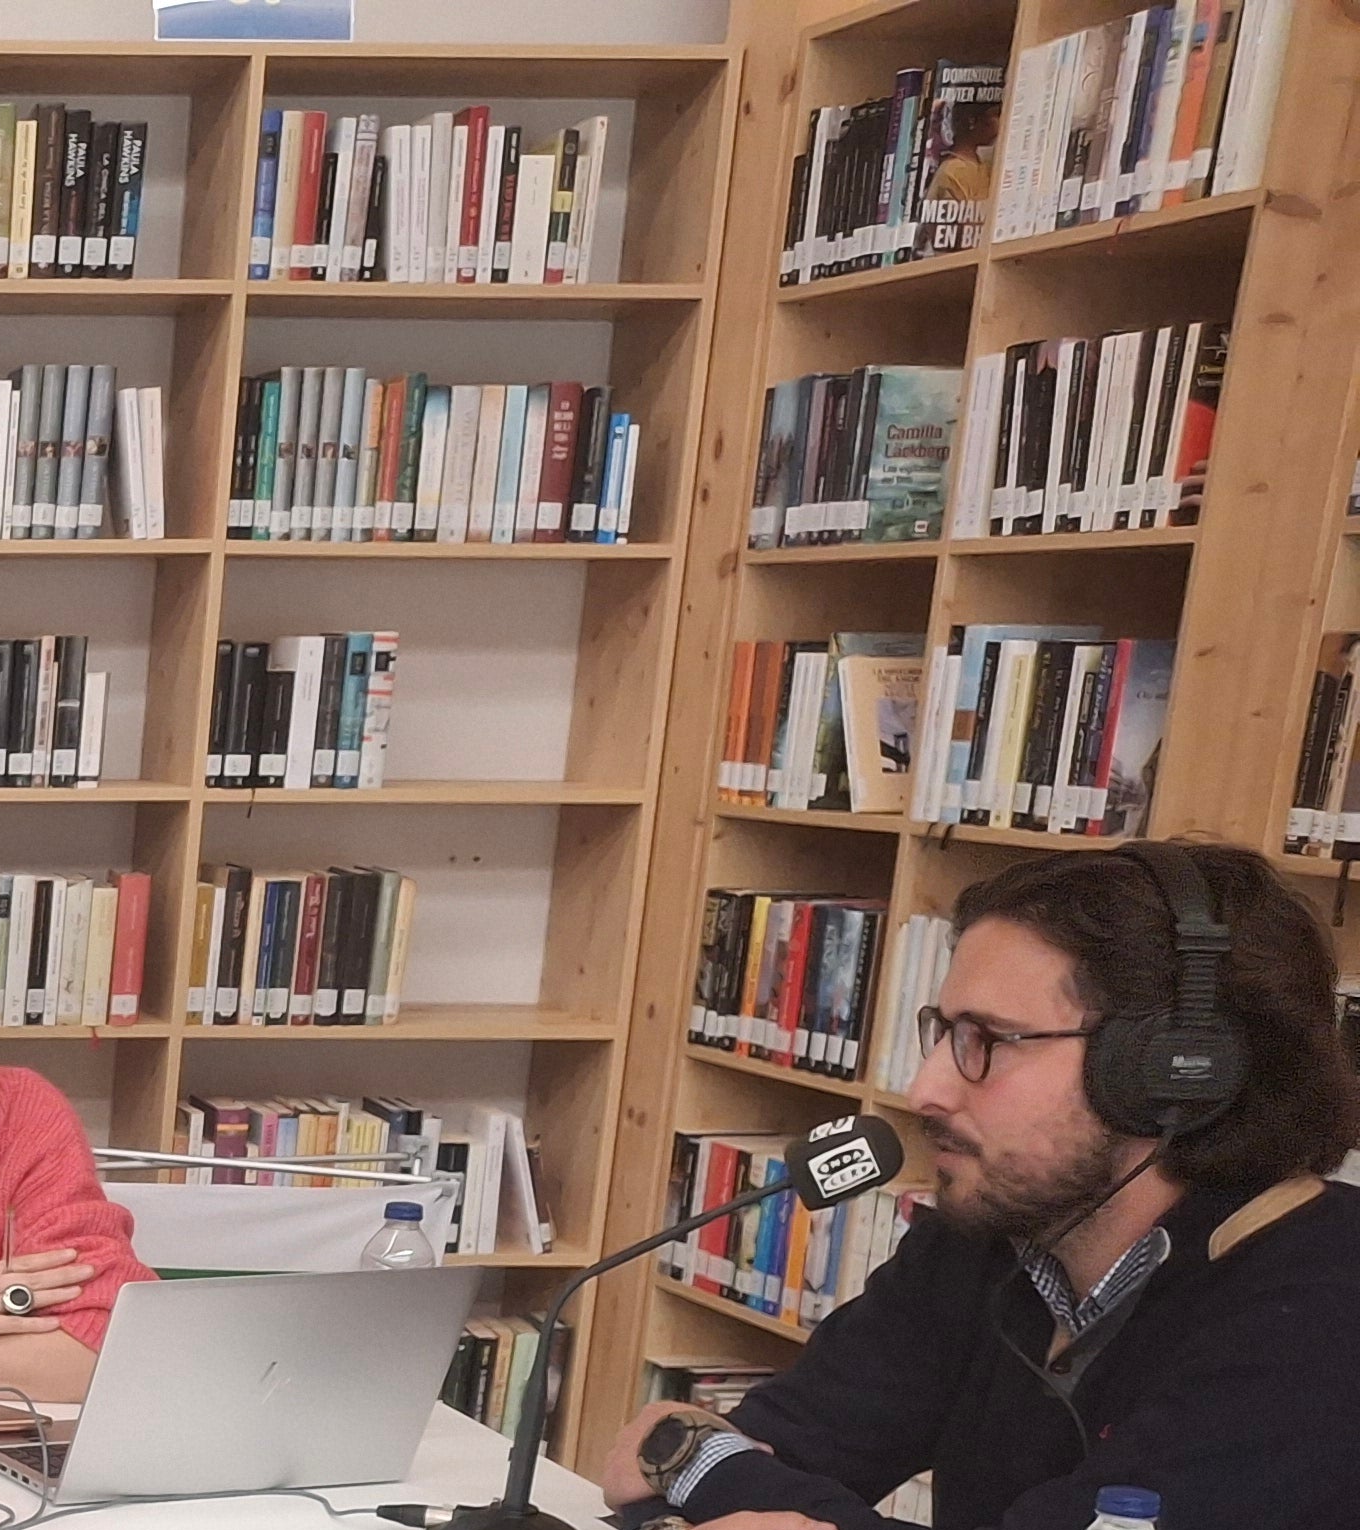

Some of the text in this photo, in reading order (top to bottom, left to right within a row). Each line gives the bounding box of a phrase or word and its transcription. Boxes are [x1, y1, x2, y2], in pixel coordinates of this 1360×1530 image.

[65, 133, 78, 187] HAWKINS
[76, 142, 87, 178] PAULA
[118, 130, 133, 184] HAWKINS
[129, 139, 142, 175] PAULA
[933, 223, 958, 249] EN
[887, 424, 942, 440] Camilla
[820, 1150, 862, 1173] ONDA
